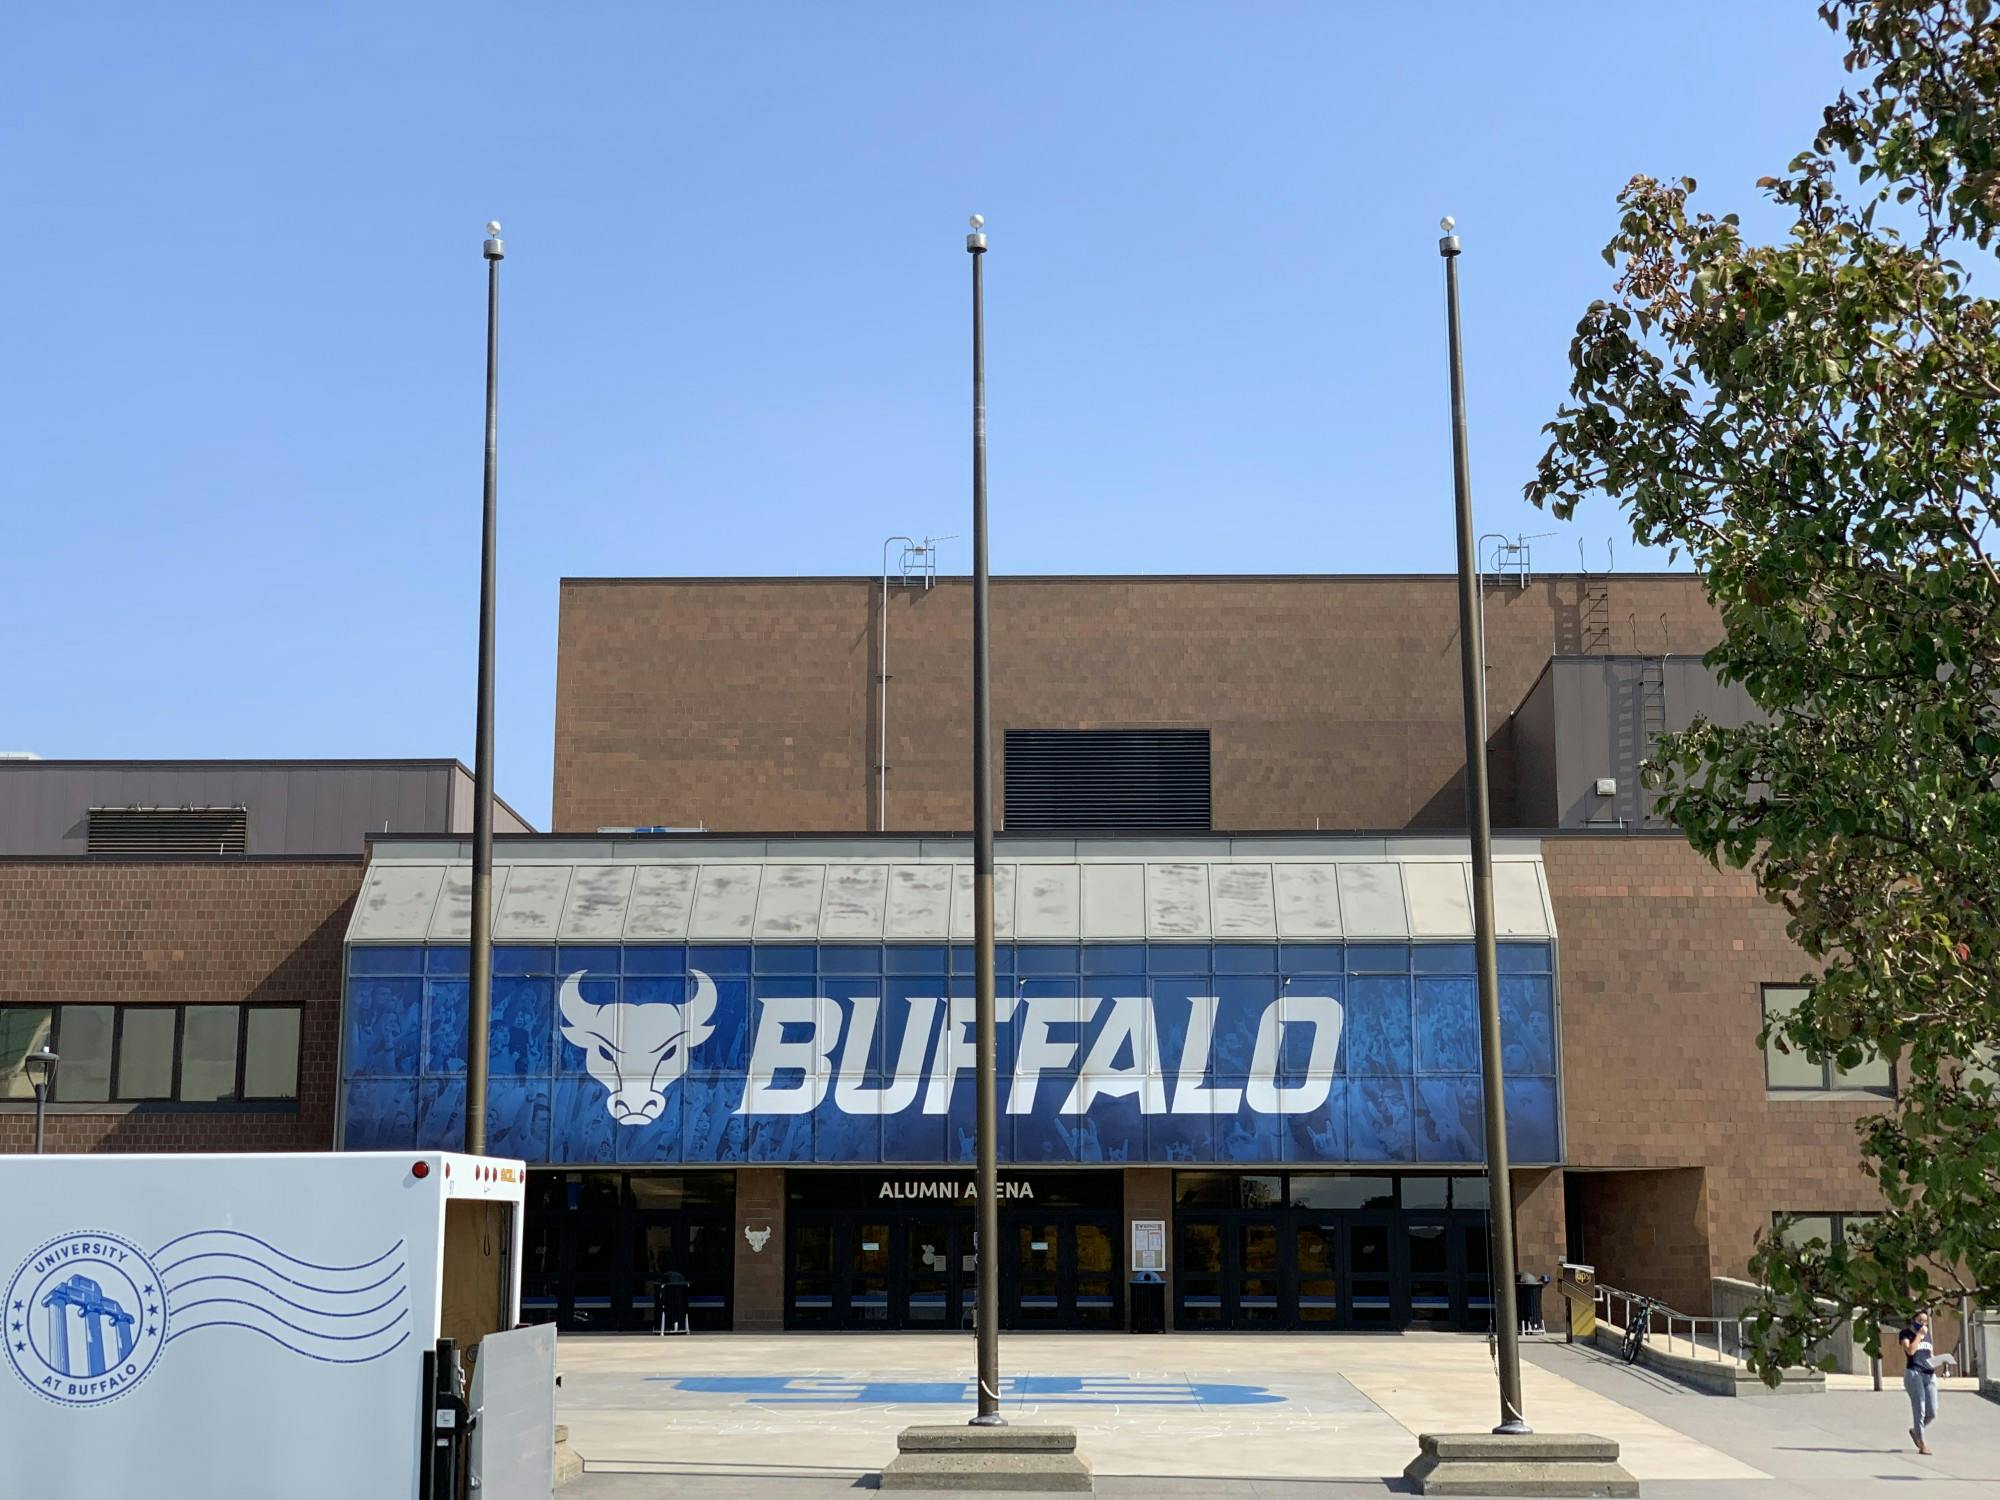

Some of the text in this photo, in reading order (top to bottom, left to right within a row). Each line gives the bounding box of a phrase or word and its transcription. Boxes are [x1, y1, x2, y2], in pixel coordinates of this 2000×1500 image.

[731, 997, 1344, 1114] BUFFALO
[879, 1182, 1034, 1199] ALUMNI AENA
[34, 1242, 129, 1273] UNIVERSITY
[42, 1364, 137, 1396] AT BUFFALO
